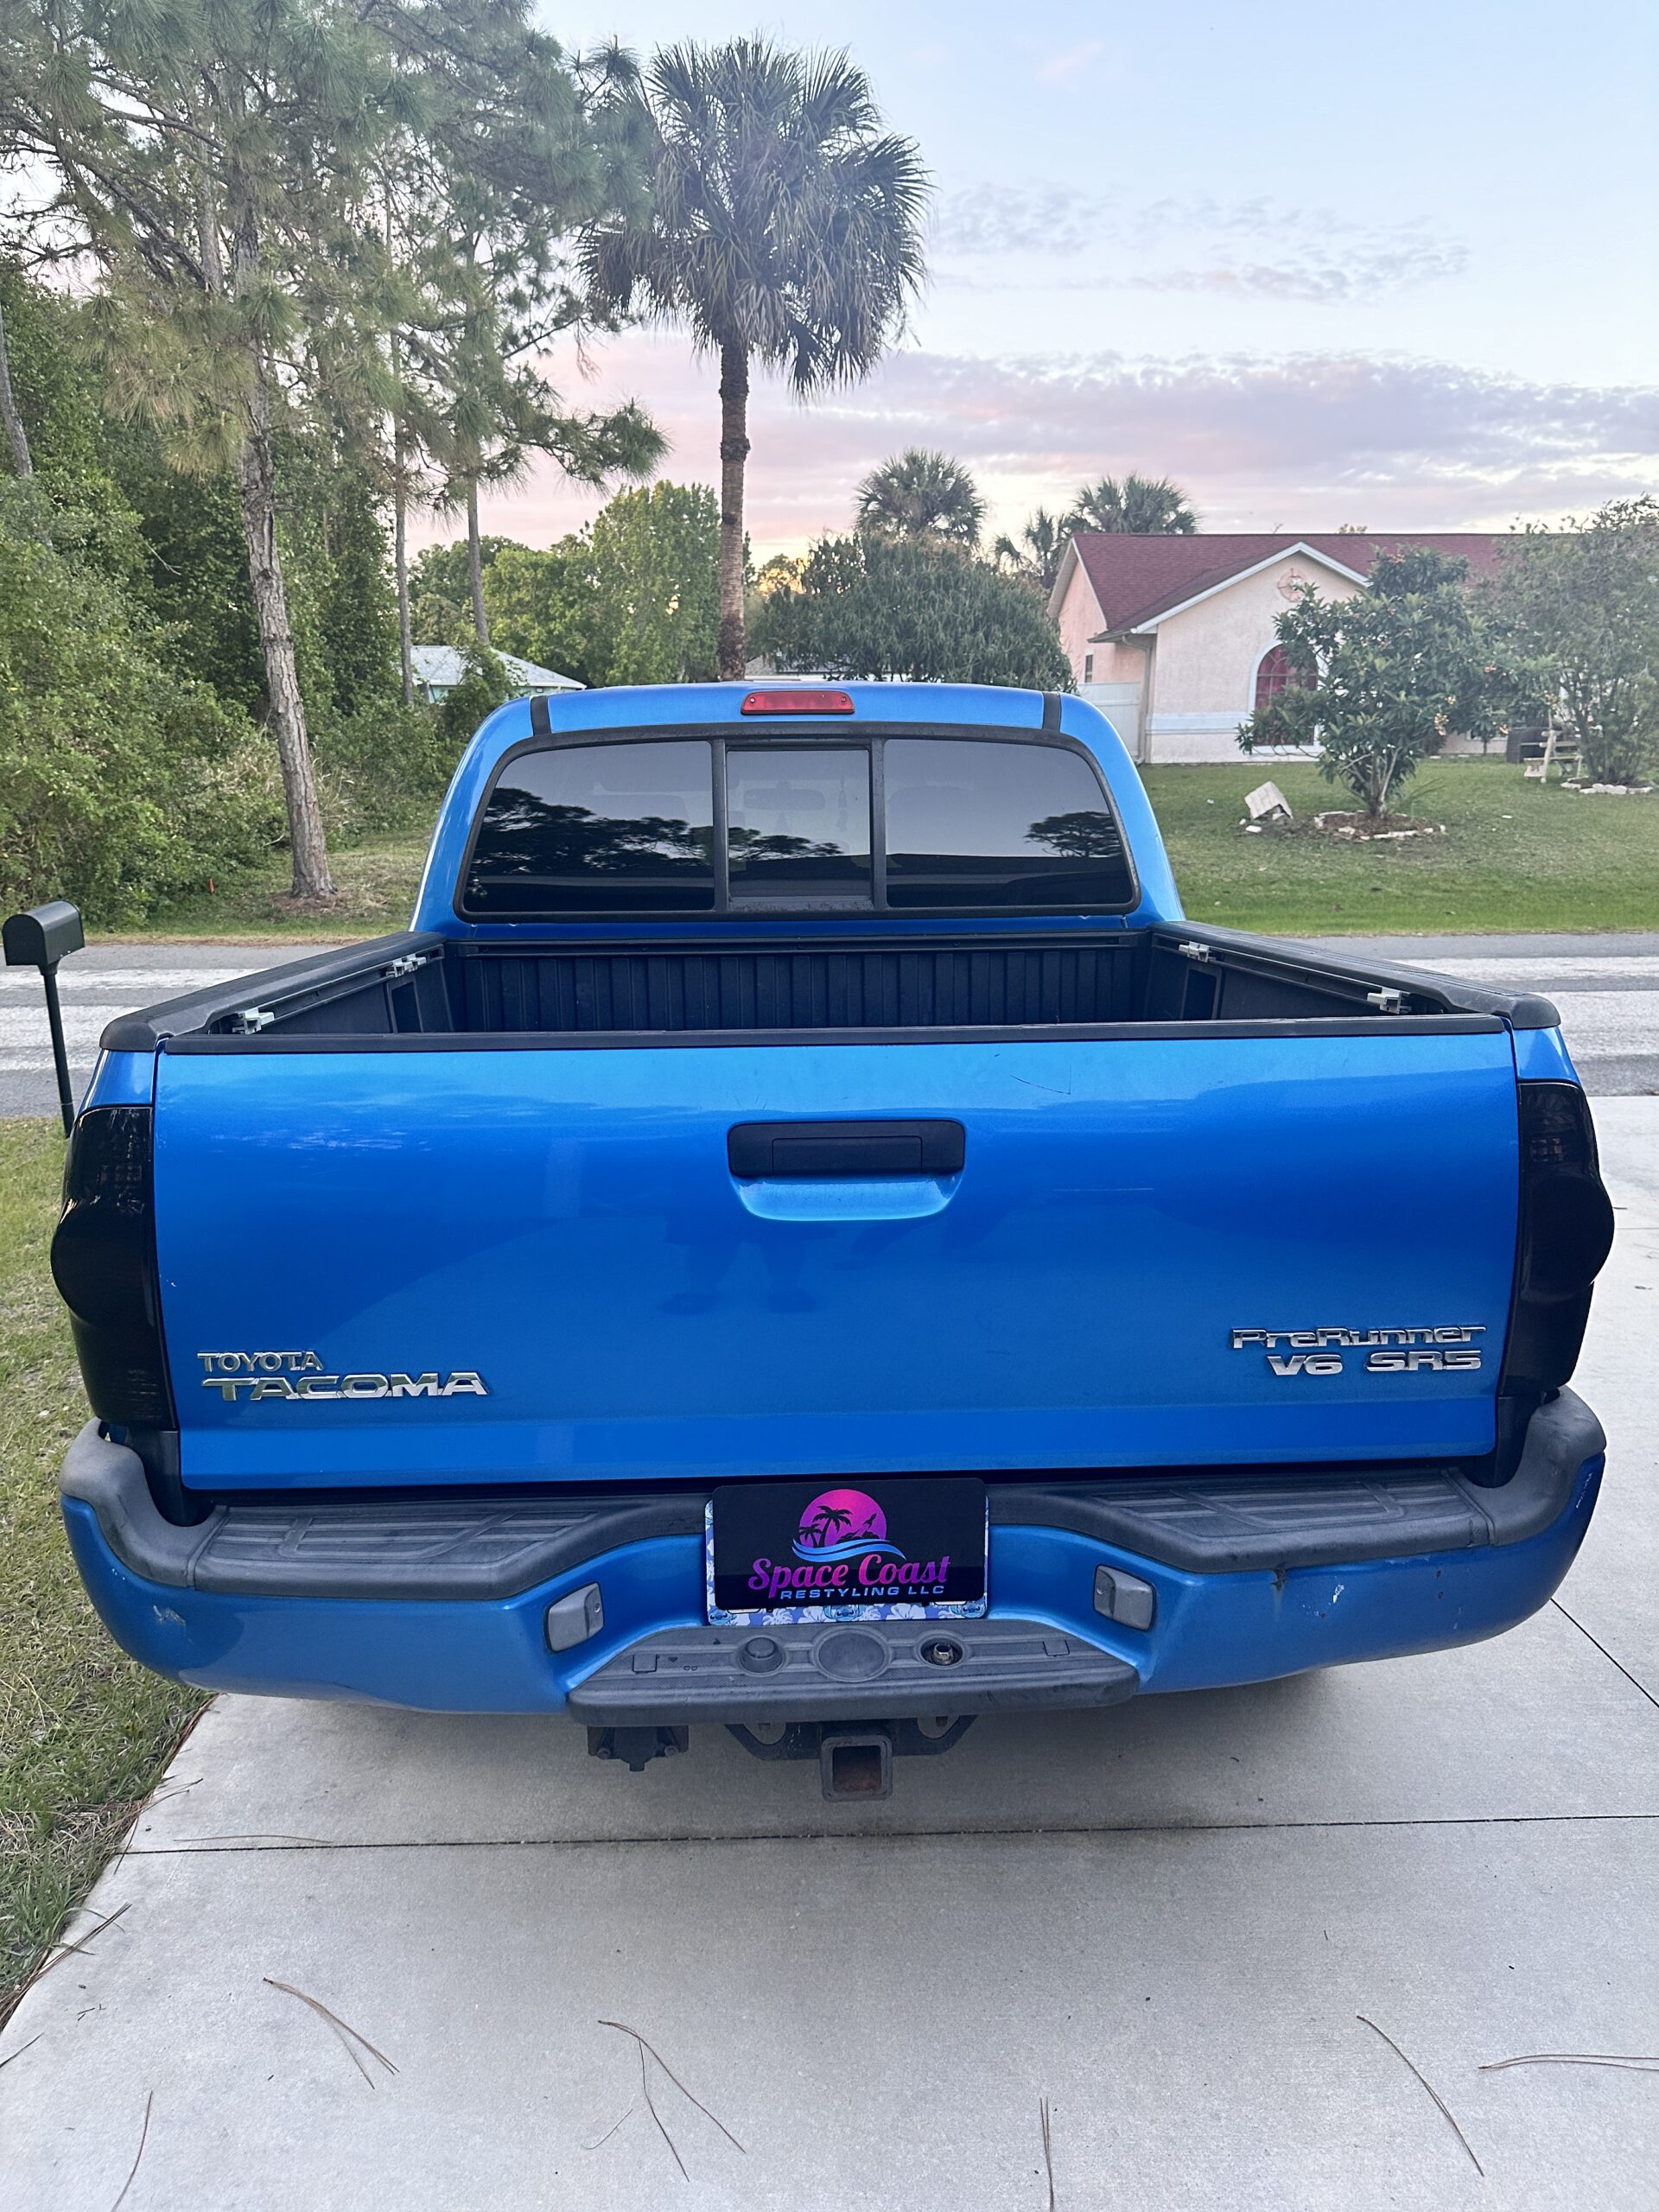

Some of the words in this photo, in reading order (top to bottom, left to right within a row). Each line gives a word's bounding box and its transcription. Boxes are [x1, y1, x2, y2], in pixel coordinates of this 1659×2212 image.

[1231, 1326, 1486, 1349] PreRunner
[197, 1351, 324, 1372] TOYOTA
[1267, 1353, 1344, 1376] V6
[1365, 1350, 1481, 1372] SR5
[201, 1371, 489, 1402] TACOMA
[747, 1557, 849, 1599] Space
[858, 1554, 950, 1585] Coast
[780, 1586, 899, 1600] RESTYLING
[907, 1585, 945, 1595] LLC
